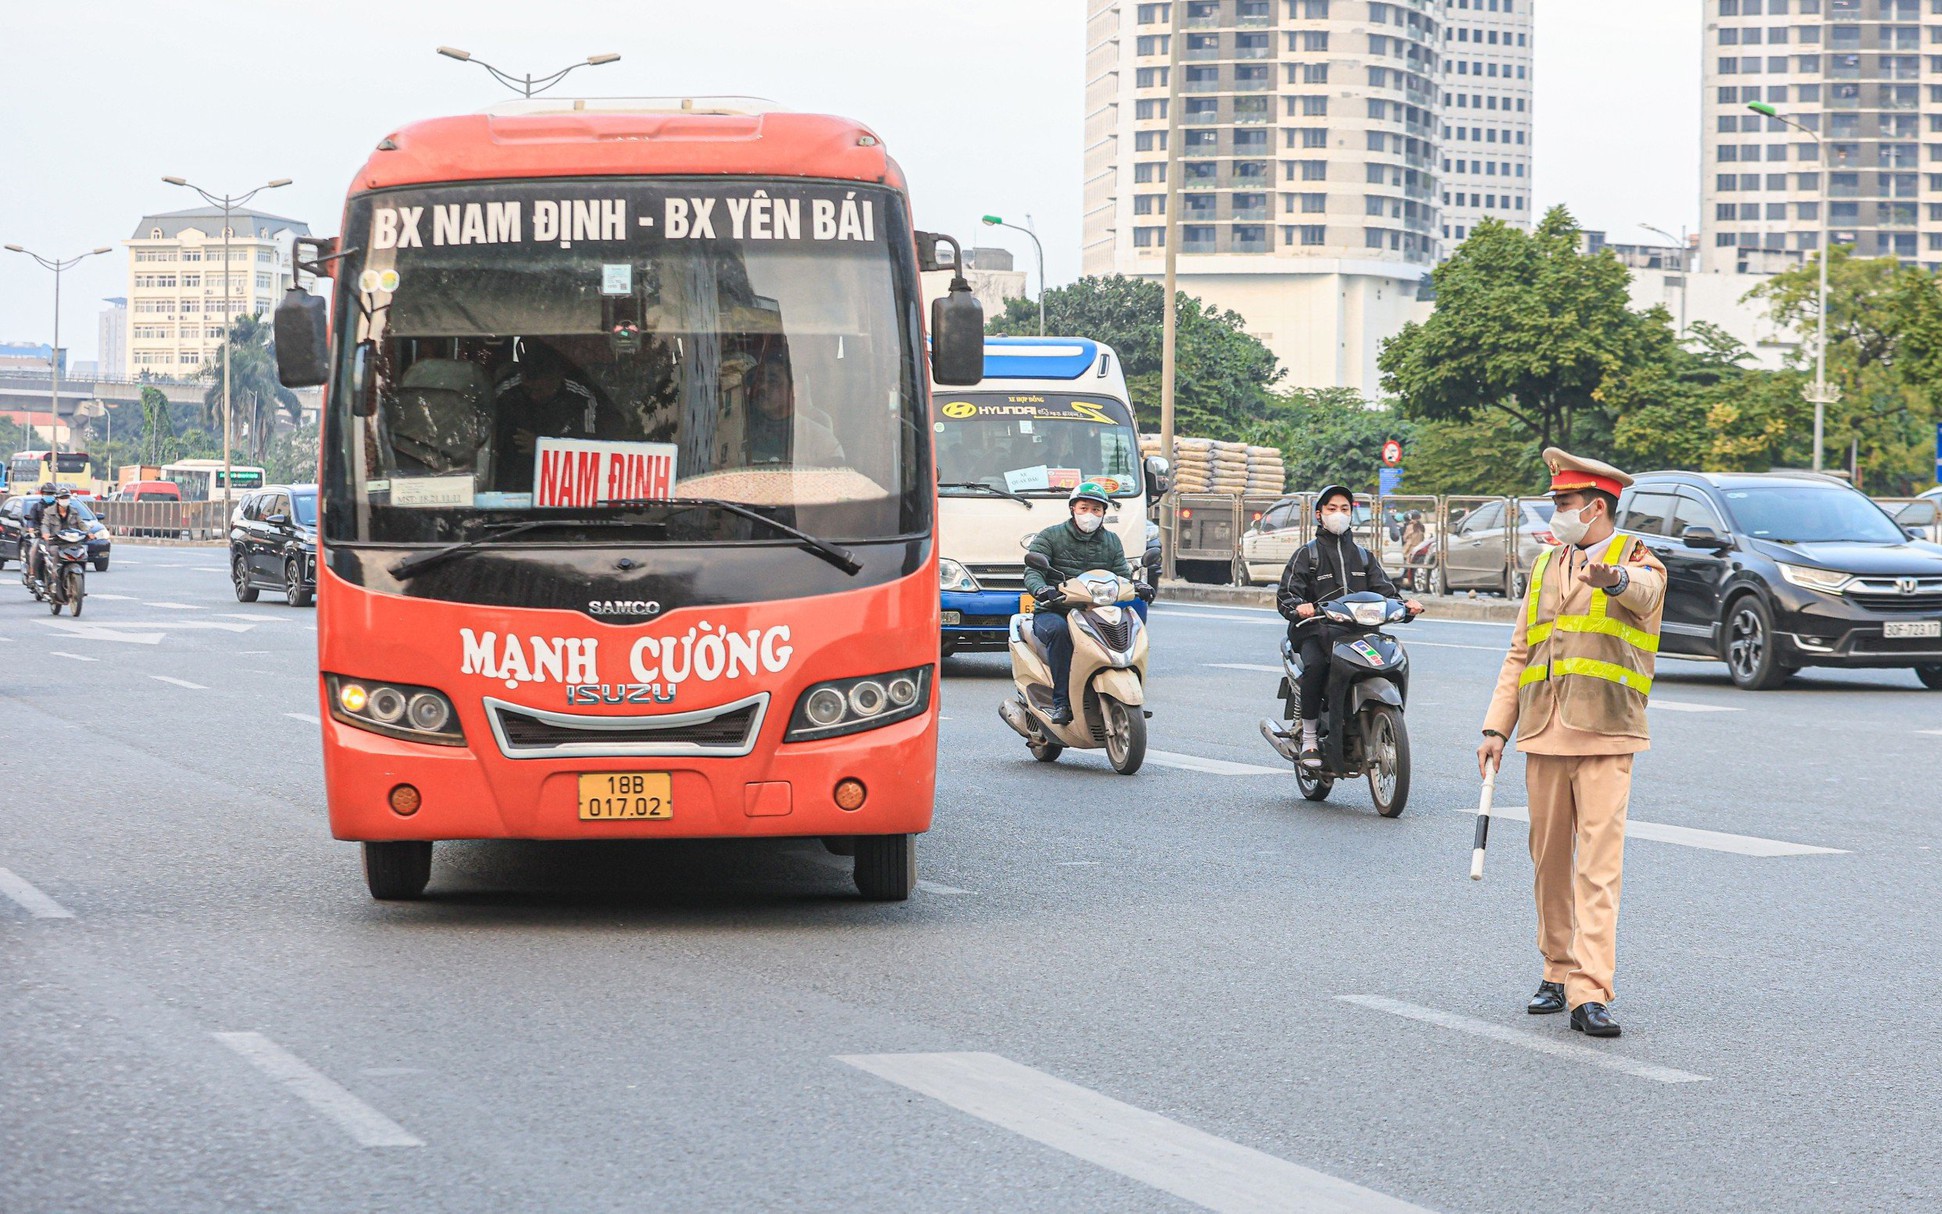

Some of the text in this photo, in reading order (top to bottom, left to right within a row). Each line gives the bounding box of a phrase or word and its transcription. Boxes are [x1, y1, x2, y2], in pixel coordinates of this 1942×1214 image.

[373, 189, 875, 250] BX NAM ĐỊNH - BX YÊN BÁI
[978, 406, 1037, 416] HYUNDAI
[538, 449, 601, 508] NAM
[588, 600, 661, 615] SAMCO
[459, 619, 794, 690] MẠNH CƯỜNG
[565, 682, 677, 705] ISUZU
[607, 775, 645, 795] 18B
[589, 797, 661, 817] 017.02
